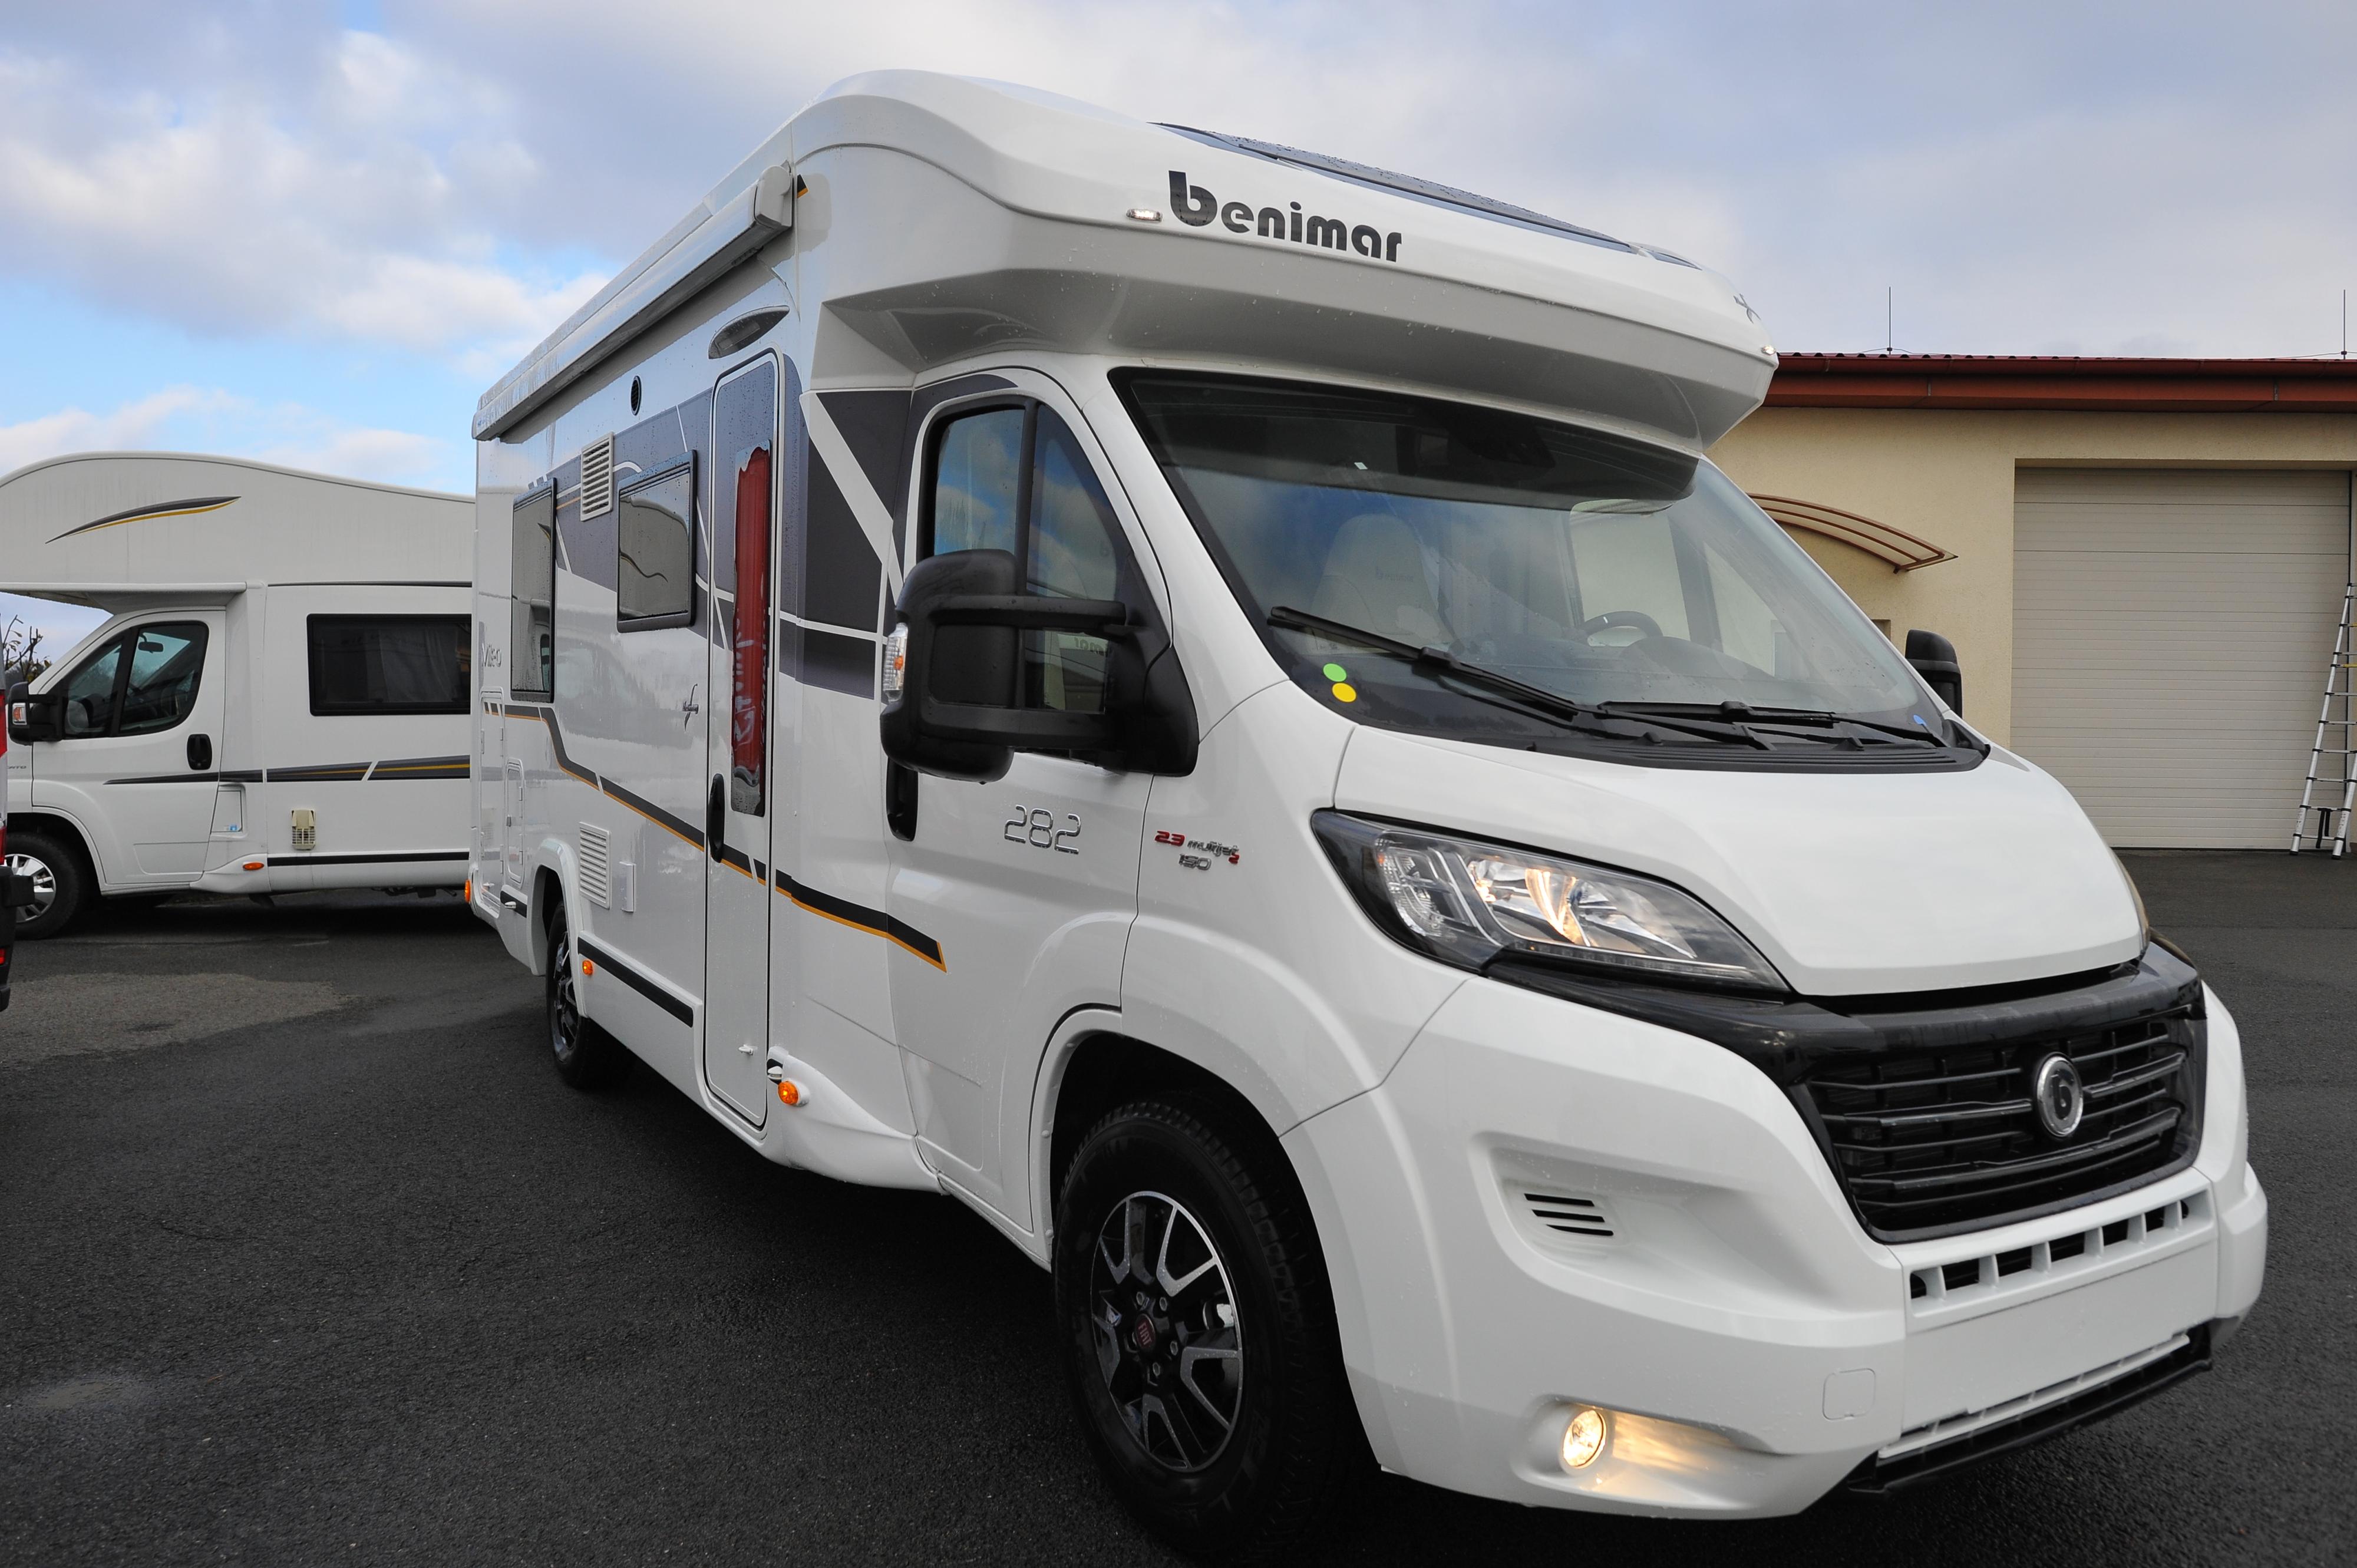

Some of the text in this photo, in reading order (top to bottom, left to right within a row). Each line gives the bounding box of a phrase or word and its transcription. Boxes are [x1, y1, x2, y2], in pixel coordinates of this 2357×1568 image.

[1168, 170, 1402, 262] benimar
[1004, 804, 1081, 854] 282
[1138, 1322, 1152, 1345] FIAT
